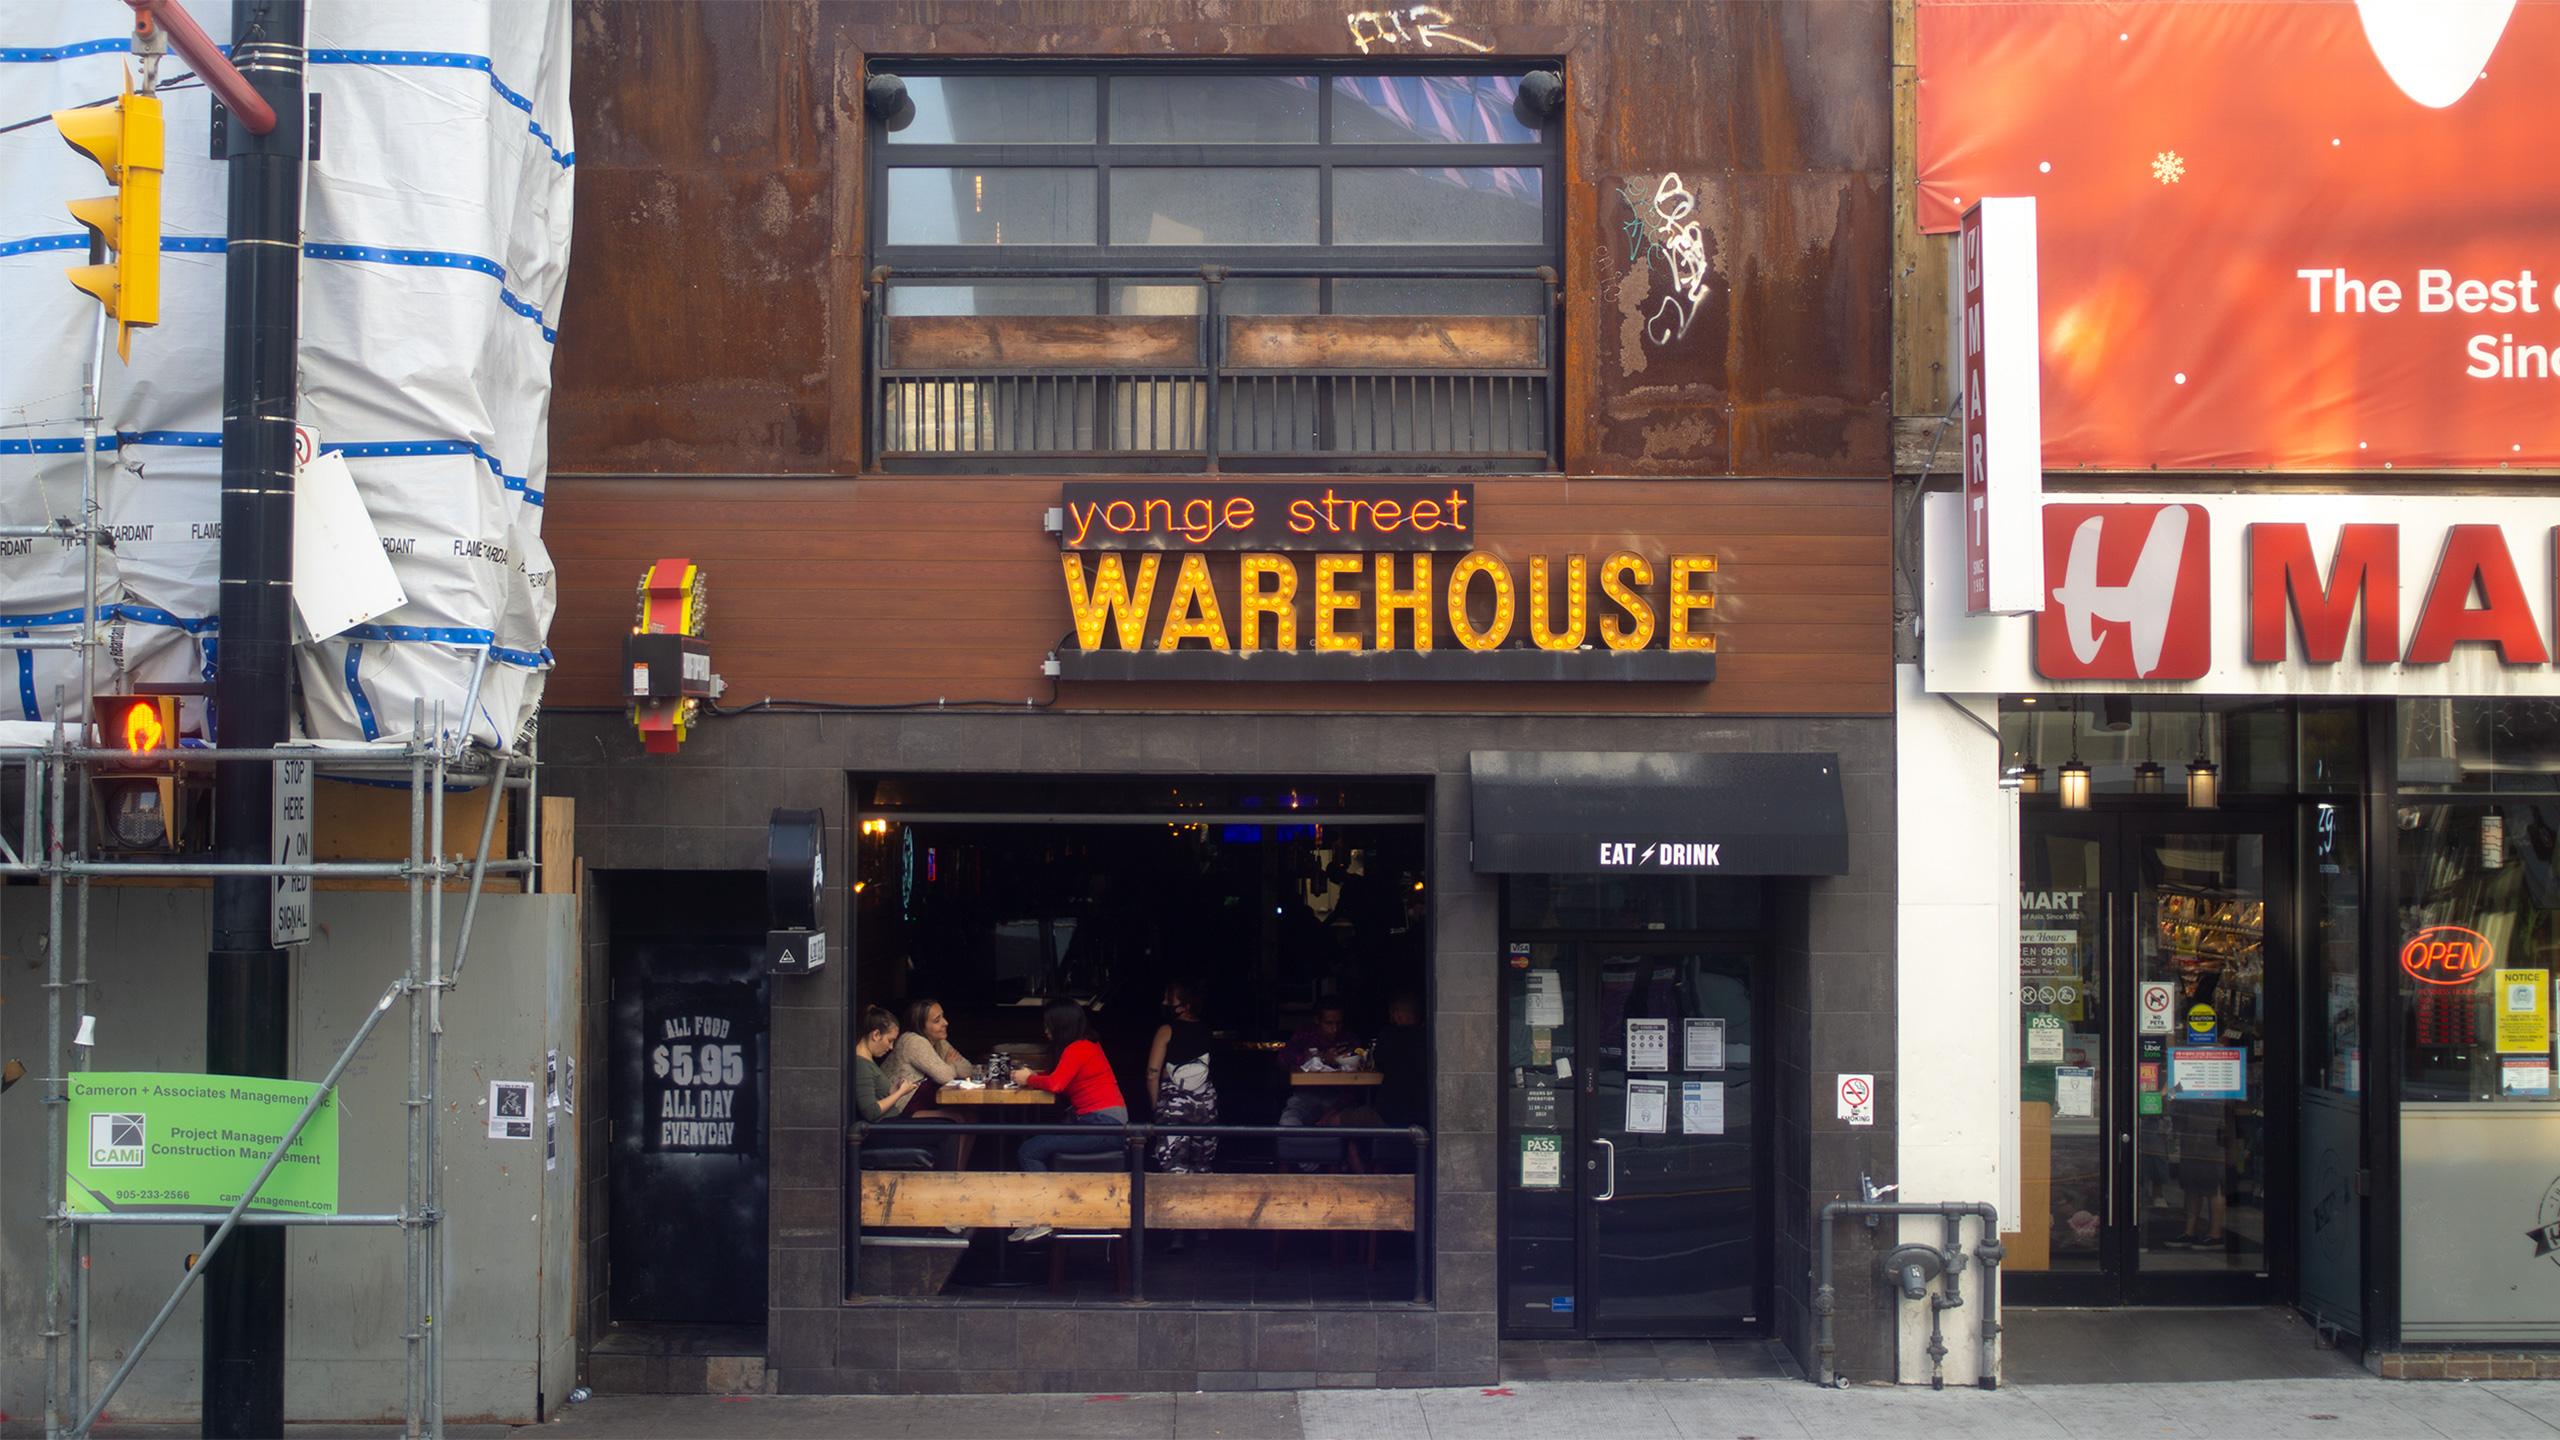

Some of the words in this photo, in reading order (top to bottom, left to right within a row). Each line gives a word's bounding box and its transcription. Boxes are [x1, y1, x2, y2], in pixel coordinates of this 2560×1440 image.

[2297, 268, 2401, 313] The
[2419, 270, 2540, 313] Best
[1968, 304, 1985, 547] MART
[1068, 497, 1256, 546] yonge
[1288, 488, 1468, 533] street
[378, 537, 416, 555] RDANT
[1061, 550, 1719, 652] WAREHOUSE
[2246, 522, 2560, 664] MA
[284, 761, 305, 784] STOP
[283, 797, 305, 820] HERE
[296, 832, 308, 856] ON
[1600, 843, 1636, 865] EAT
[1660, 843, 1720, 866] DRINK
[278, 904, 307, 930] SIGNAL
[1511, 944, 1529, 952] VISA
[2020, 947, 2037, 956] EN
[2040, 947, 2068, 956] 09:00
[2407, 941, 2484, 970] OPEN
[2040, 958, 2068, 966] 24:00
[2504, 973, 2541, 982] NOTICE
[665, 1017, 691, 1039] ALL
[695, 1016, 730, 1039] FOOD
[2032, 1018, 2060, 1028] PASS
[653, 1044, 743, 1086] $5.95
[75, 1084, 137, 1097] Cameron
[153, 1085, 226, 1100] Associates
[230, 1091, 309, 1107] Management
[661, 1089, 696, 1118] ALL
[700, 1089, 735, 1118] DAY
[171, 1127, 217, 1143] Project
[221, 1129, 304, 1148] Managemnt
[661, 1121, 735, 1145] EVERYDAY
[151, 1144, 236, 1158] Construction
[239, 1147, 321, 1166] Manaement
[1527, 1141, 1556, 1151] PASS
[116, 1190, 190, 1200] 905-233-2566
